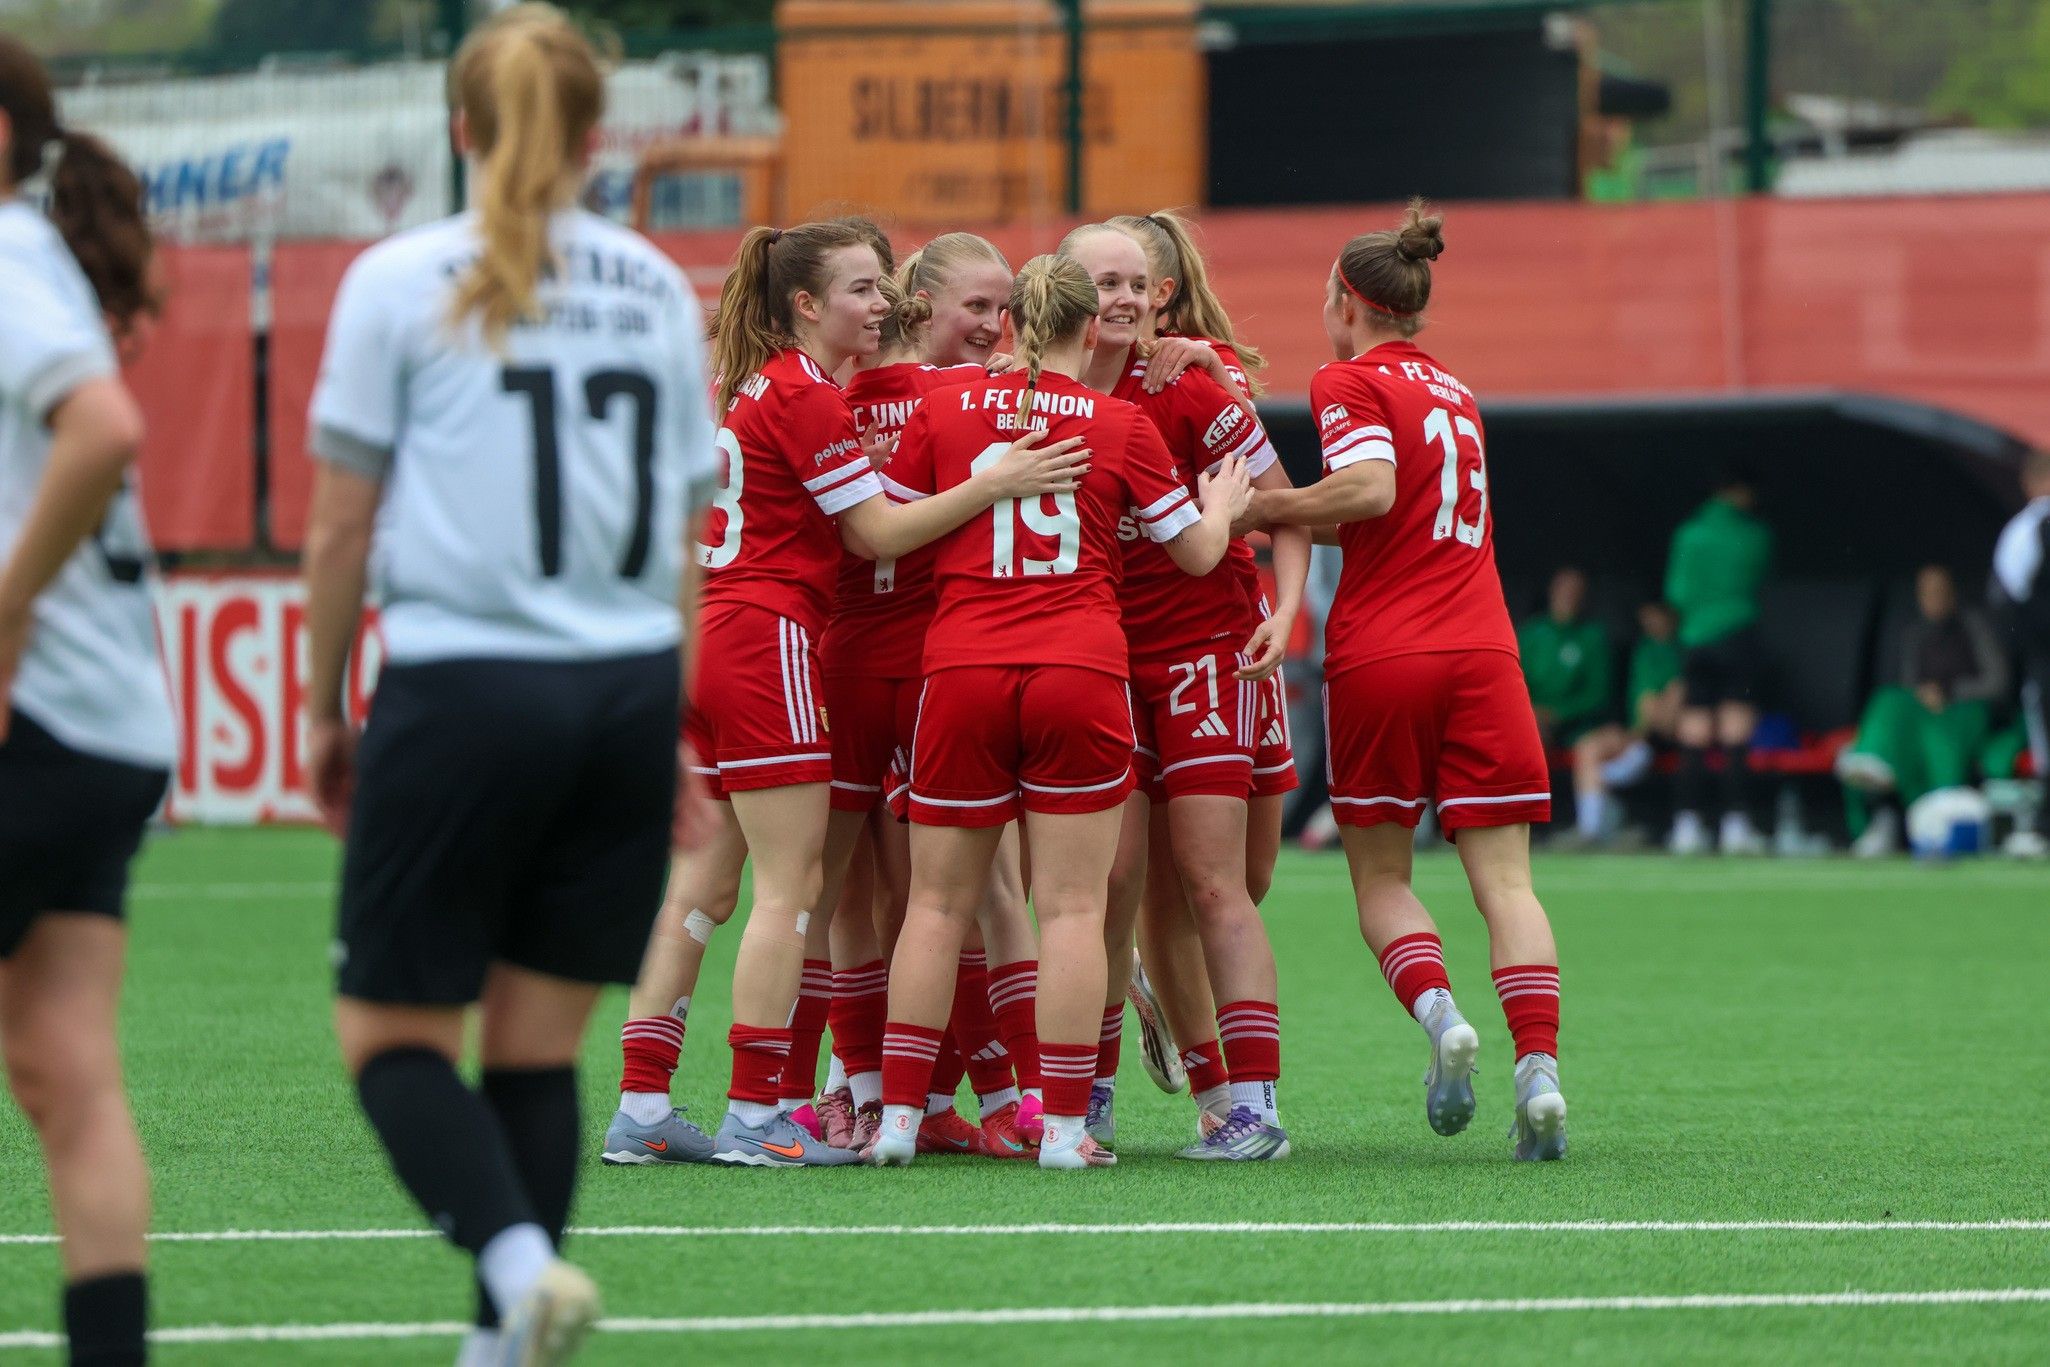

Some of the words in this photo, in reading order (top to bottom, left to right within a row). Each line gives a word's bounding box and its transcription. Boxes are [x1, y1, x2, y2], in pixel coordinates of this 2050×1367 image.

[960, 390, 976, 410] 1.
[983, 388, 1013, 410] FC
[1400, 361, 1430, 381] FC
[502, 366, 656, 578] 17
[970, 442, 1080, 577] 19
[1423, 407, 1487, 549] 13
[1168, 654, 1219, 716] 21
